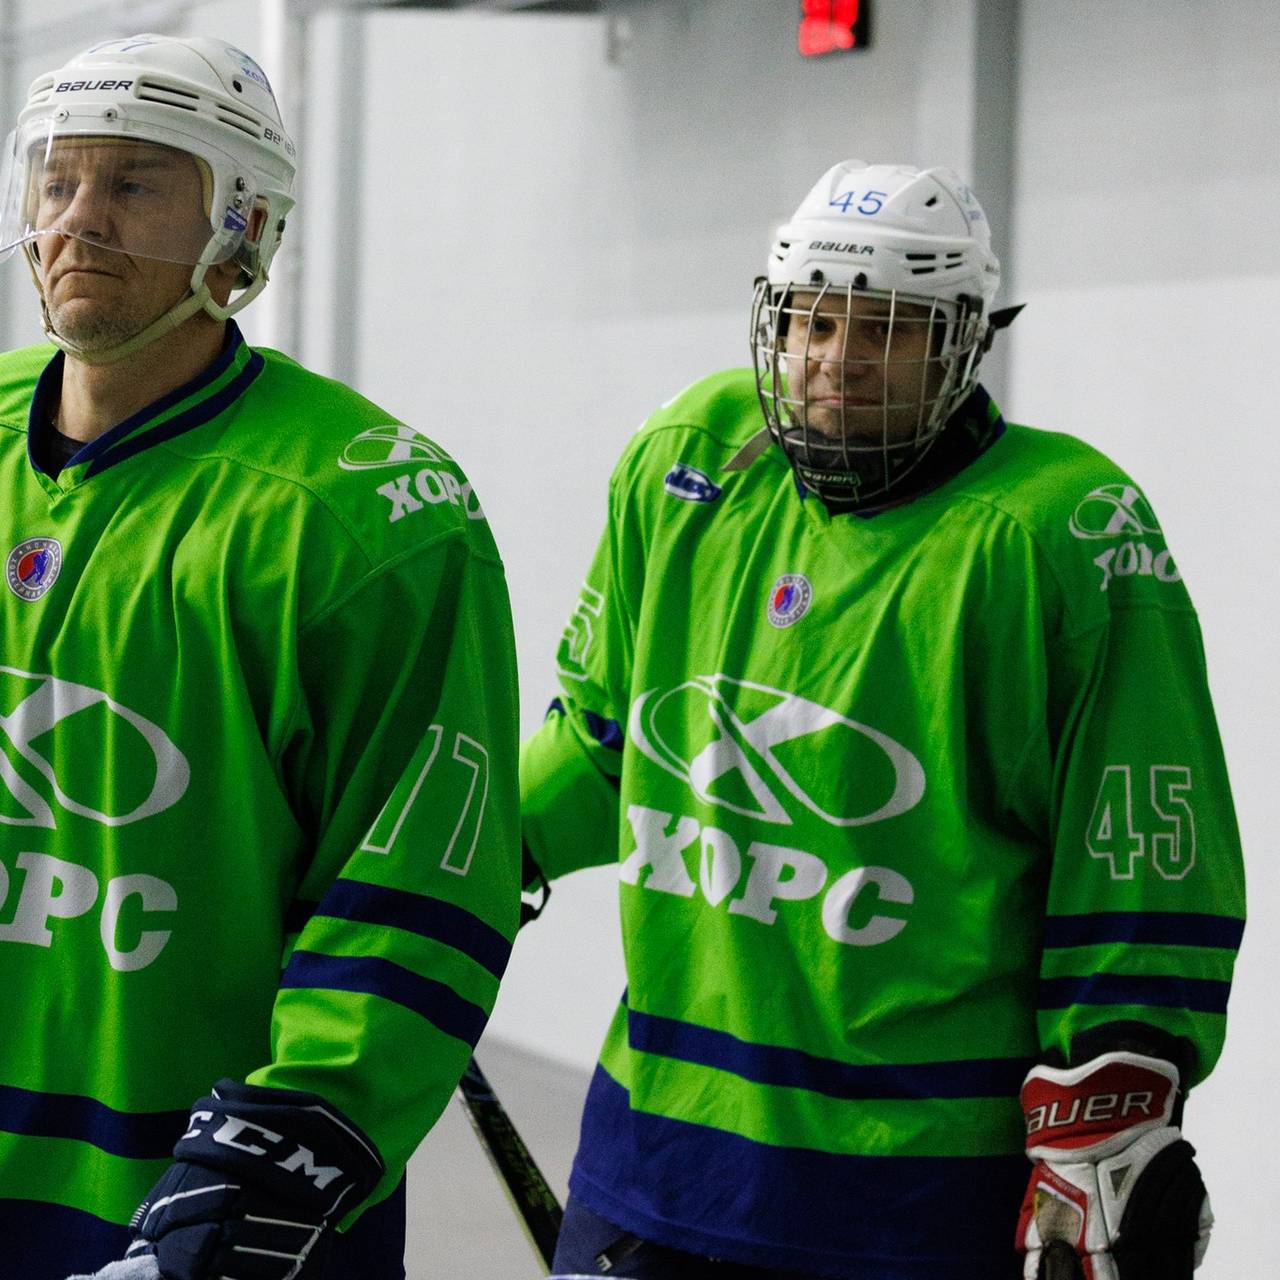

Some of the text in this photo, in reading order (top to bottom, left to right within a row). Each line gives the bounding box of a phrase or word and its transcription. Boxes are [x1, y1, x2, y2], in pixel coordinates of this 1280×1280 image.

[55, 79, 133, 94] BAUER
[828, 190, 888, 216] 45
[808, 240, 875, 256] BAUER
[1084, 764, 1197, 882] 45
[619, 804, 915, 947] ХОРС
[1026, 1091, 1154, 1135] AUER
[181, 1110, 344, 1191] CCM
